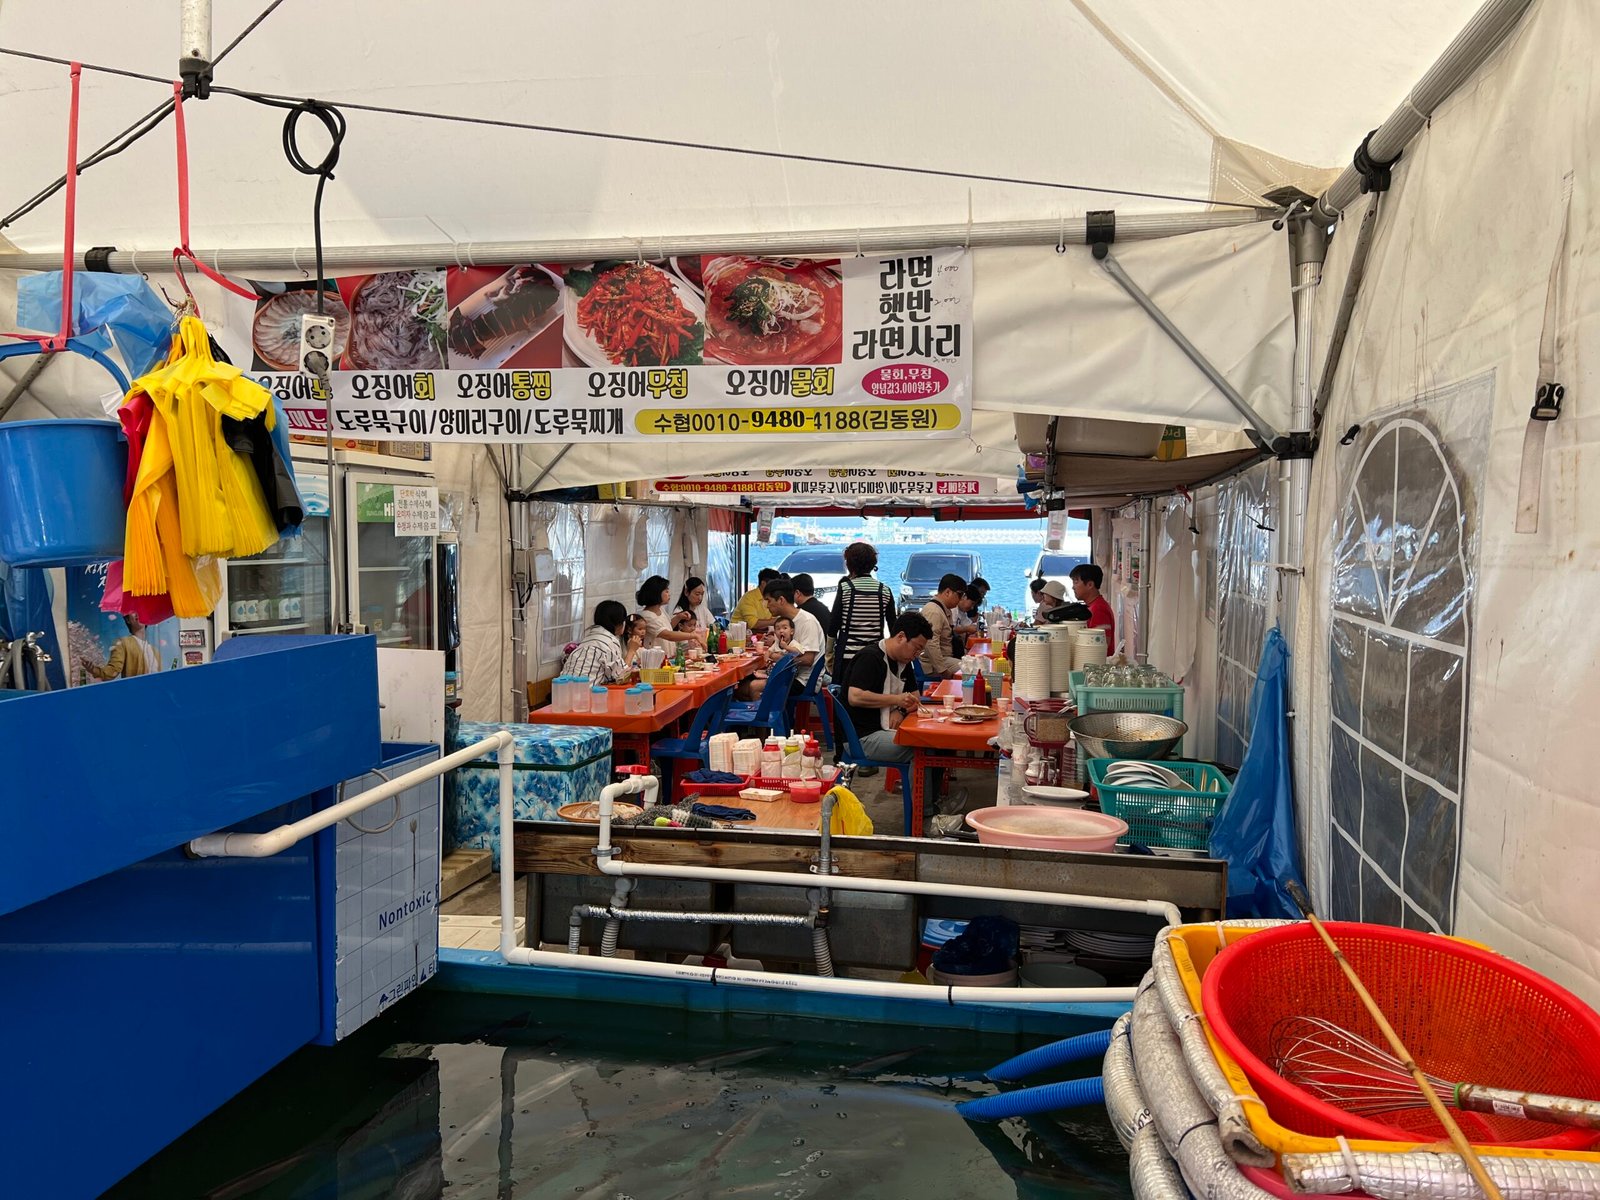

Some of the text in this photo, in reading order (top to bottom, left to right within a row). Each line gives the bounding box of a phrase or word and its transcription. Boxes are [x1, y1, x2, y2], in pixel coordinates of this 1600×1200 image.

[879, 255, 933, 291] 라면
[879, 289, 934, 325] 햇반
[852, 323, 961, 360] 라면사리
[351, 372, 436, 401] 오징어회
[457, 370, 552, 401] 오징어통찜
[587, 368, 689, 400] 오징어무침
[725, 366, 835, 398] 오징어물회
[379, 890, 432, 931] Nontoxic
